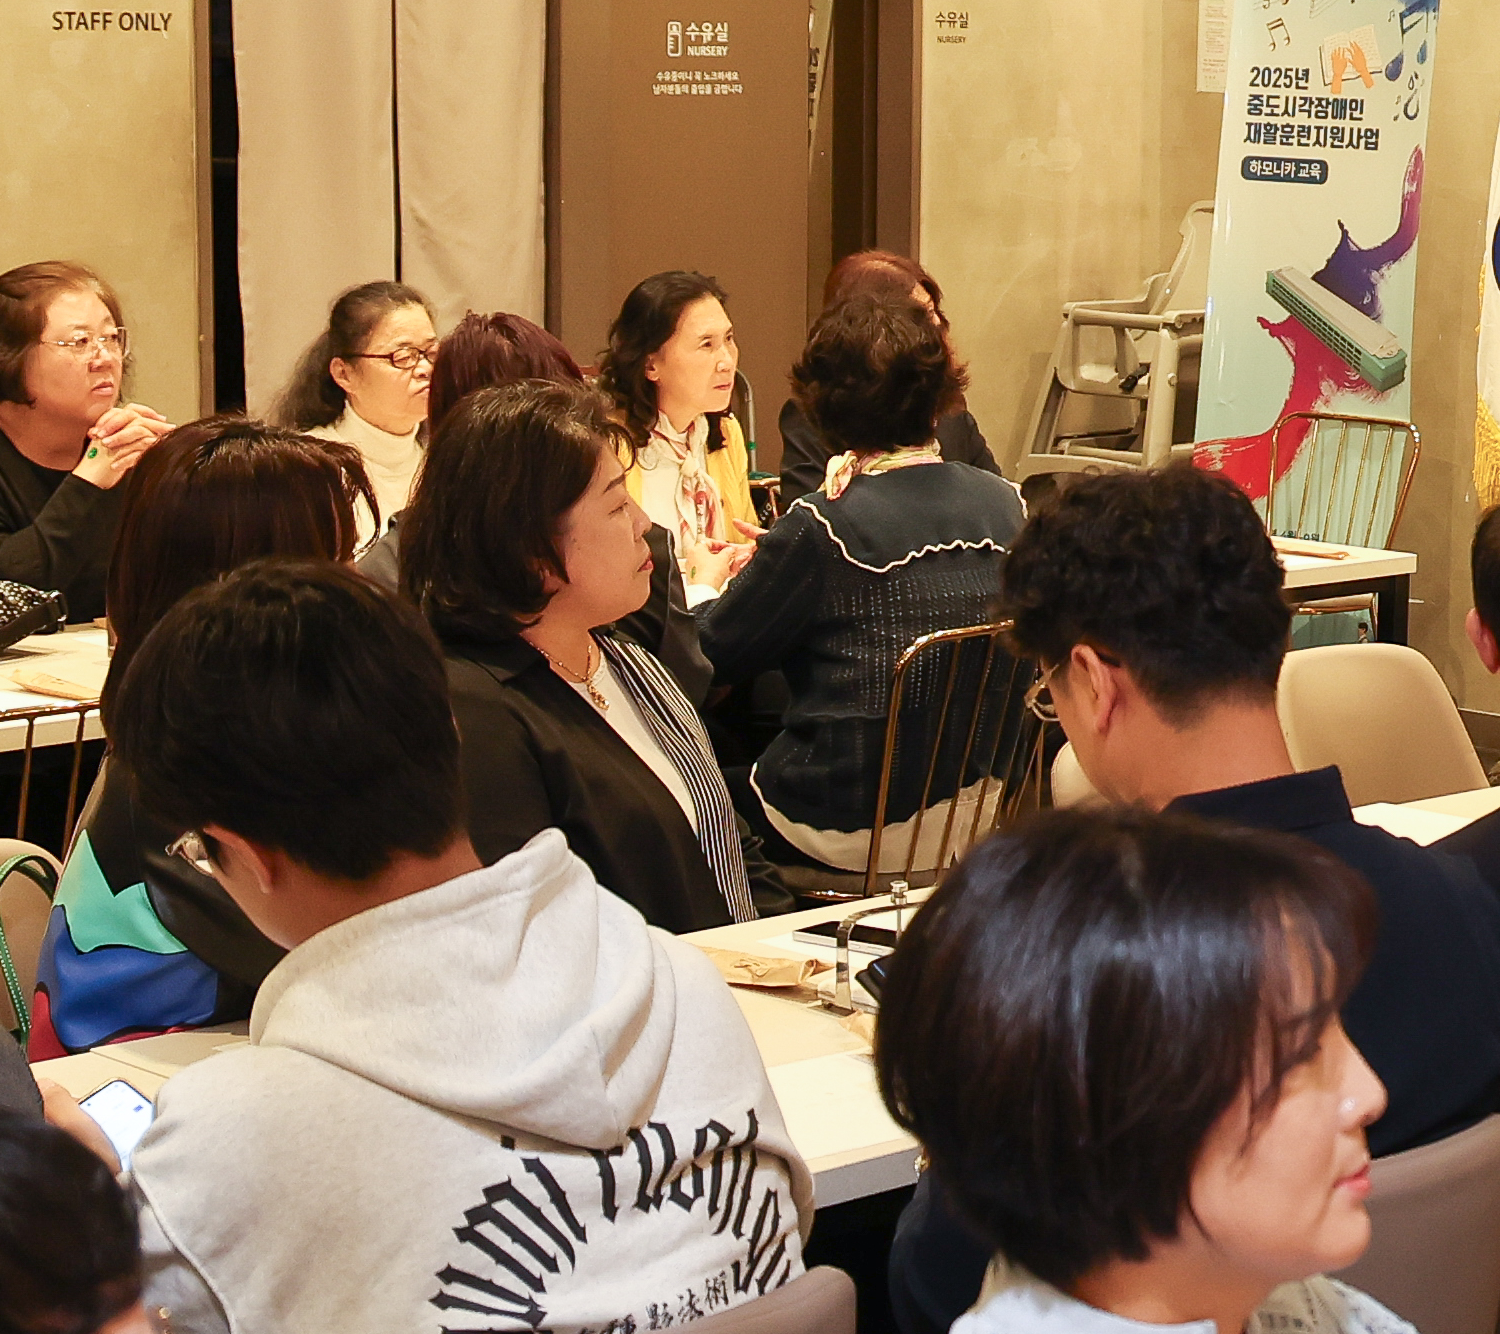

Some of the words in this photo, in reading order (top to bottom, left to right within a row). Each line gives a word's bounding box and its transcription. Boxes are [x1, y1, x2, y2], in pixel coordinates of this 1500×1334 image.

[52, 11, 113, 31] STAFF
[119, 12, 172, 31] ONLY
[935, 11, 969, 29] 수유실
[685, 22, 729, 44] 수유실
[936, 35, 967, 44] NURSERY
[687, 45, 729, 57] NURSERY
[1249, 66, 1310, 90] 2025년
[1247, 93, 1364, 121] 중도시각장애인
[1243, 121, 1380, 151] 재활훈련지원사업
[1249, 159, 1296, 179] 하모니카
[1297, 162, 1322, 181] 교육
